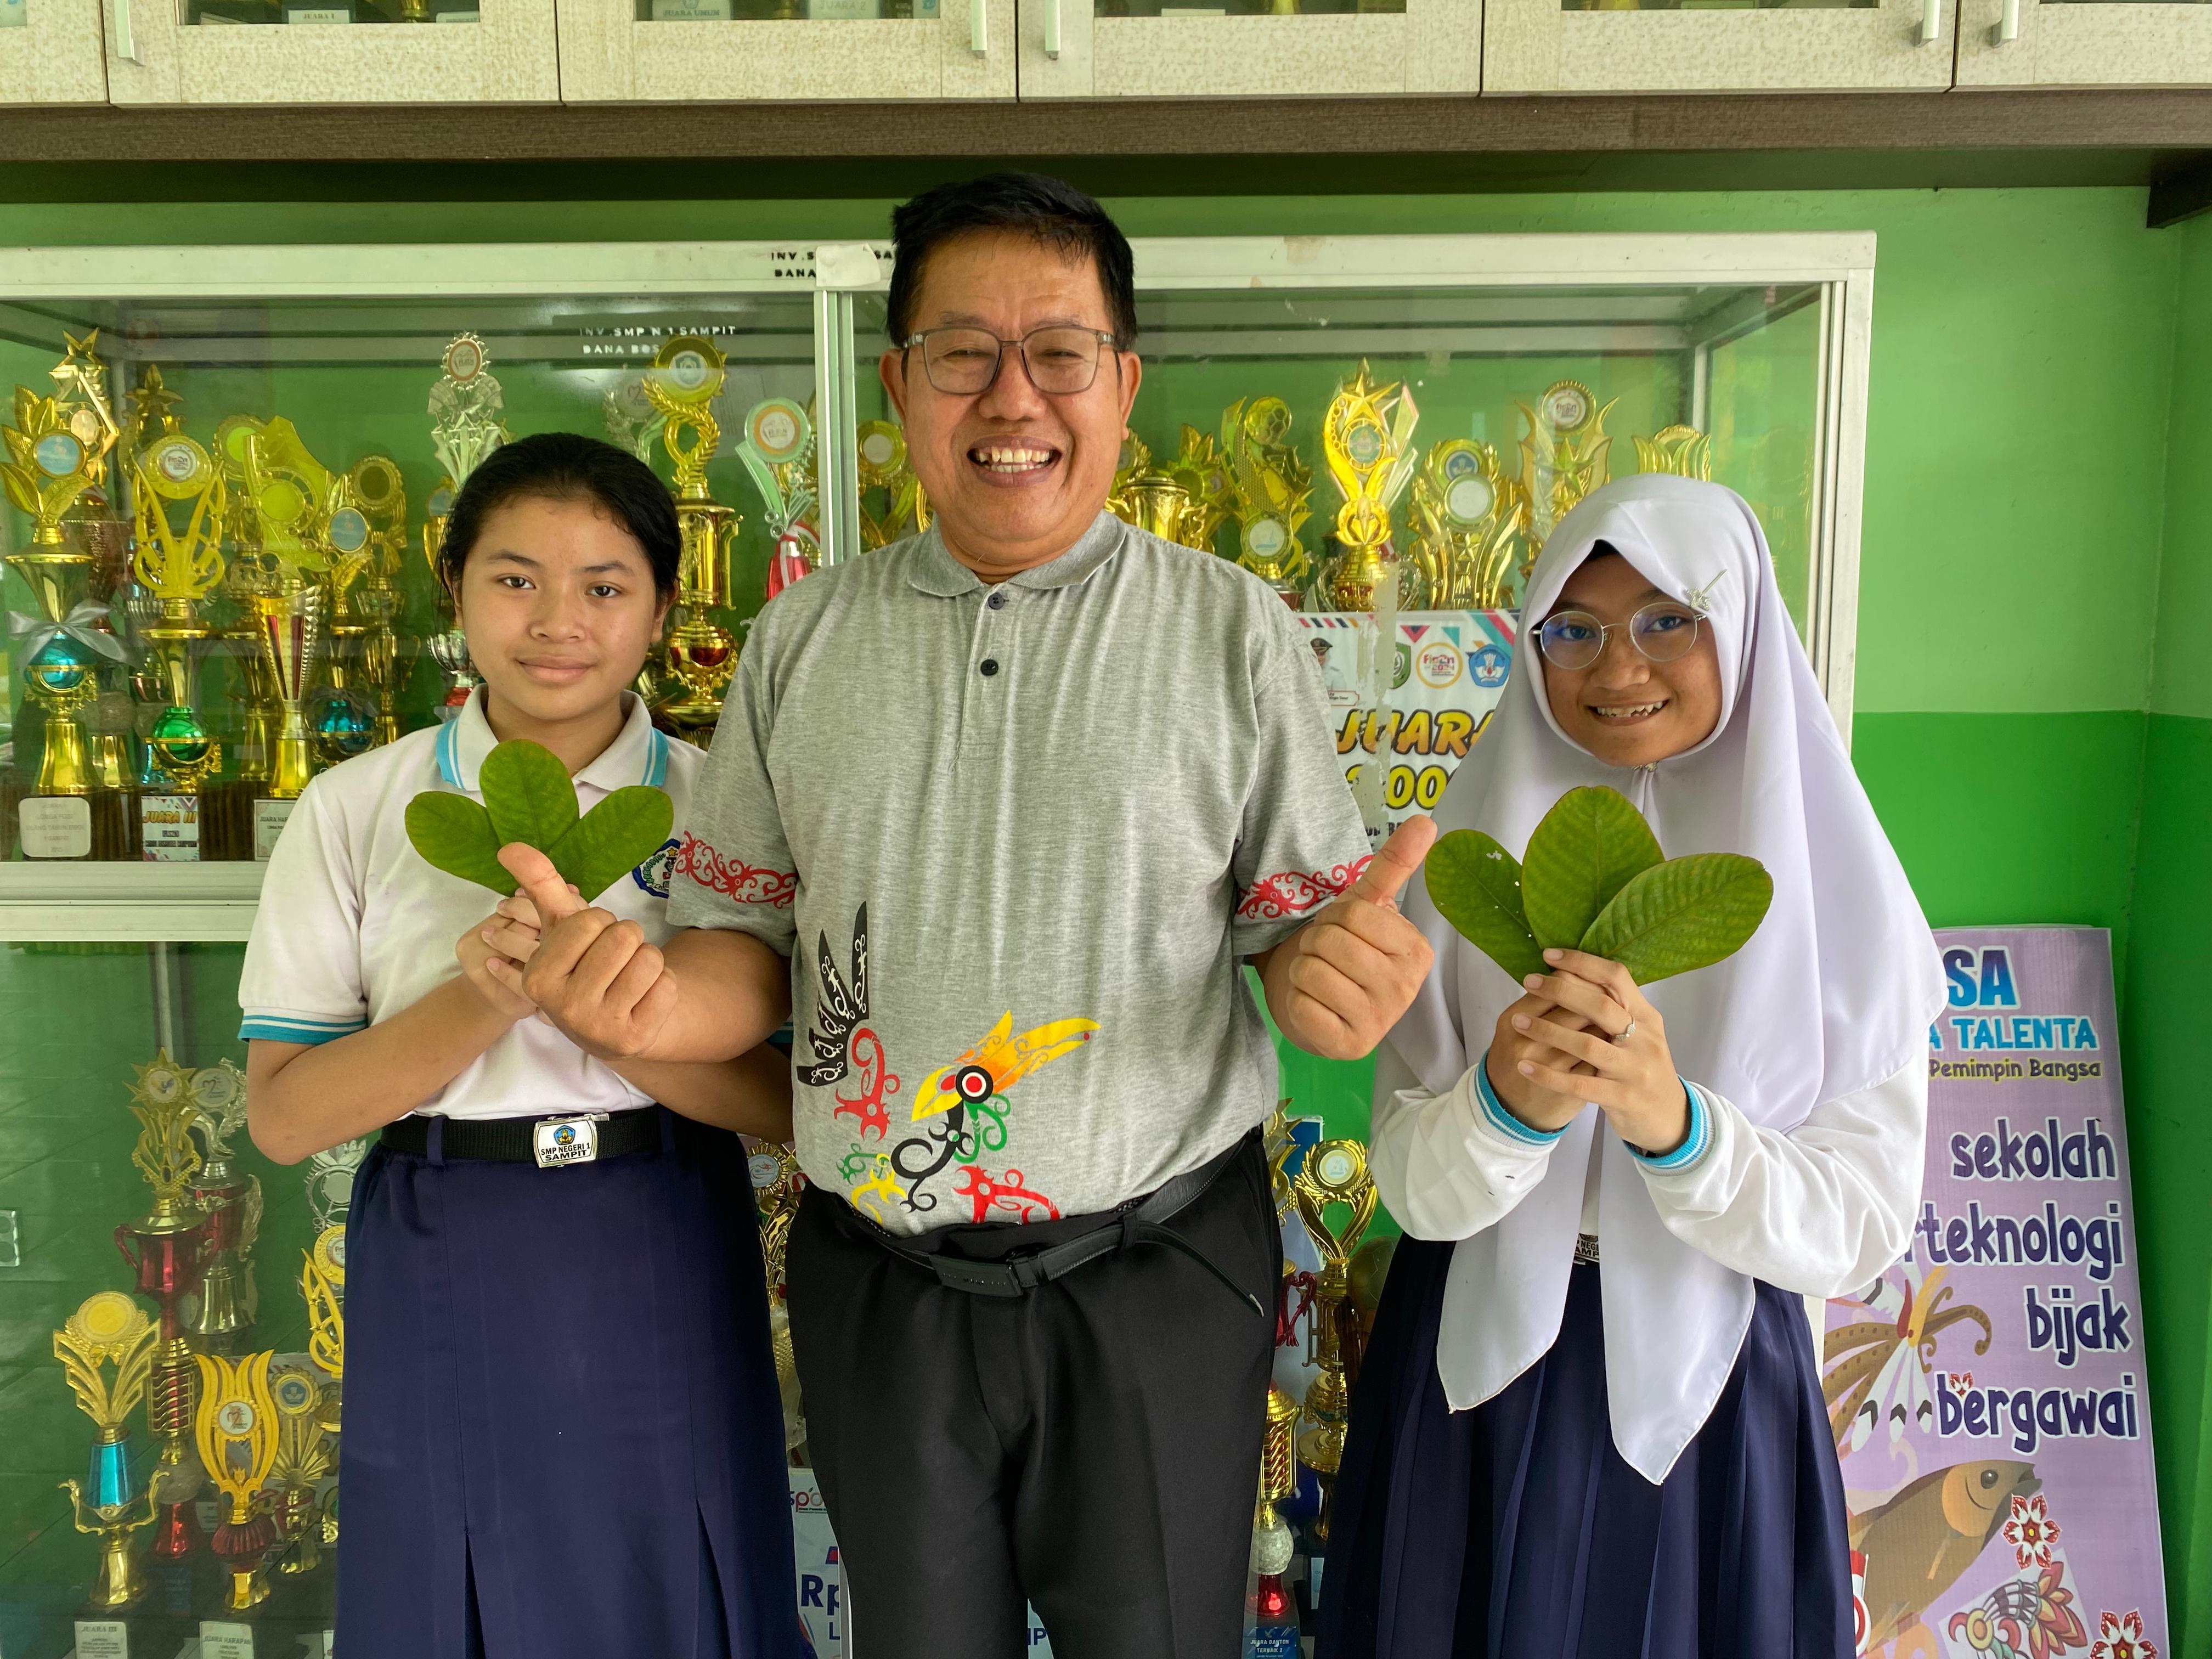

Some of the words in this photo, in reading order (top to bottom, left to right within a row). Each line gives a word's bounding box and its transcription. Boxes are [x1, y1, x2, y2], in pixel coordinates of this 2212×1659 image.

[680, 326, 736, 336] SAMPIT
[583, 345, 624, 354] DANA
[142, 810, 180, 824] JUARA
[183, 811, 197, 823] III
[1953, 1018, 2098, 1049] TALENTA
[1929, 1058, 2023, 1082] Pemimpin
[2030, 1058, 2101, 1082] Bangsa
[541, 1147, 557, 1155] SMP
[558, 1143, 584, 1153] NEGERI
[545, 1149, 587, 1161] SAMPIT
[1952, 1118, 2116, 1179] sekolah
[2025, 1285, 2132, 1367] bijak
[1936, 1372, 2140, 1454] bergawai
